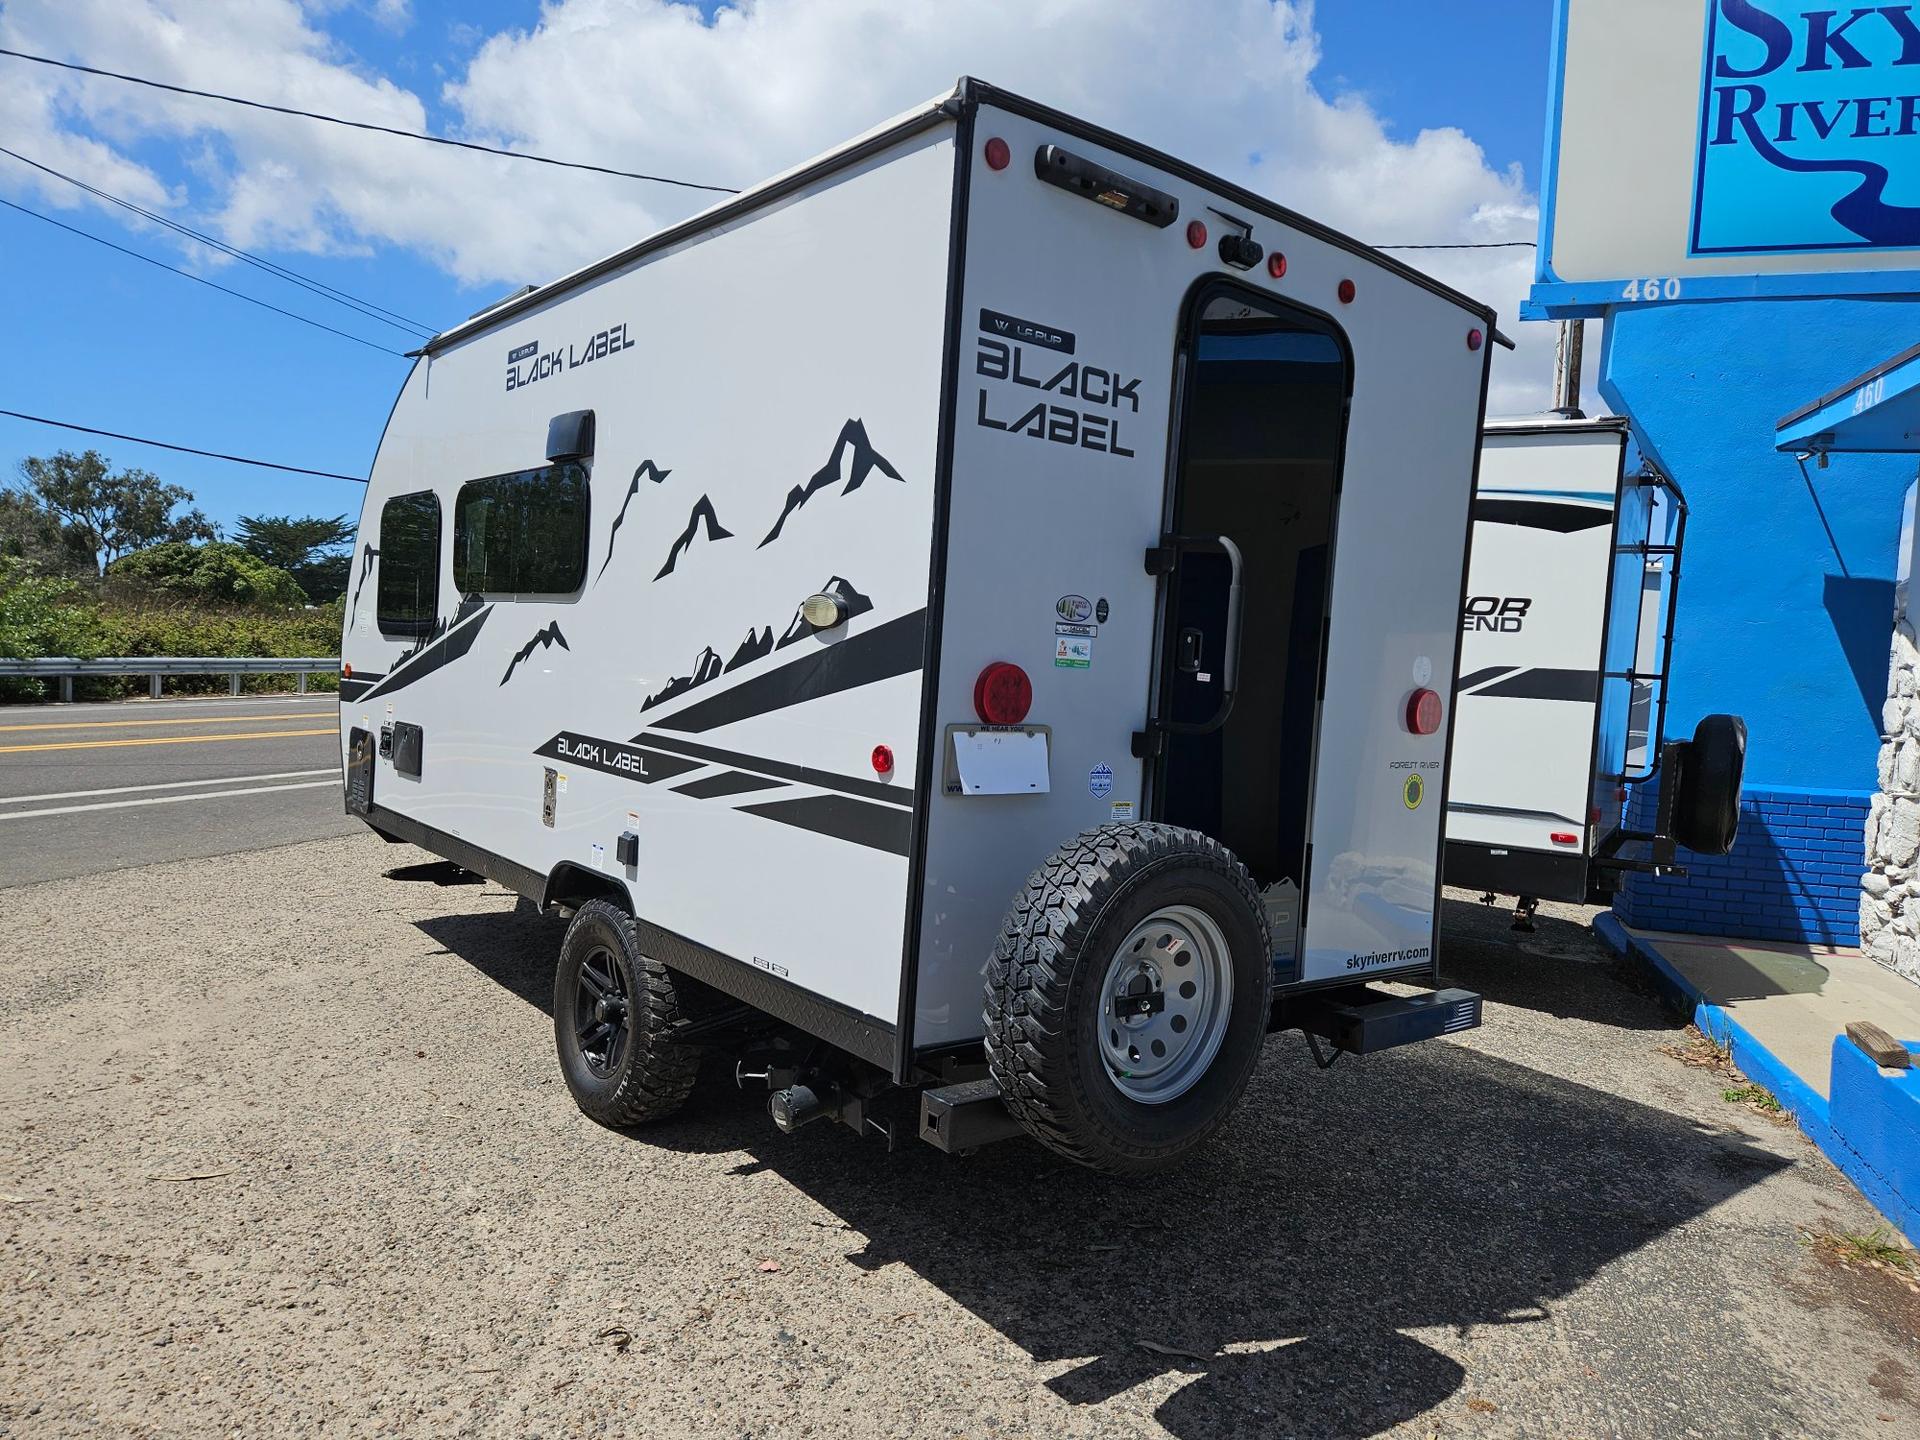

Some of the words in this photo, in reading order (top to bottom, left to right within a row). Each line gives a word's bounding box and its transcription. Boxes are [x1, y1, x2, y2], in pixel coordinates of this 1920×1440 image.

[1622, 277, 1680, 301] 460
[506, 347, 564, 391] BLACK
[569, 323, 635, 369] LABEL
[976, 336, 1143, 413] BLACK
[1853, 378, 1884, 416] 460
[978, 388, 1135, 458] LABEL
[1465, 596, 1532, 616] OR
[557, 738, 600, 763] BLACK
[603, 748, 649, 775] LABEL
[1389, 761, 1418, 769] FOREST
[1419, 761, 1440, 769] RIVER
[1346, 947, 1429, 970] skyriverrv.com
